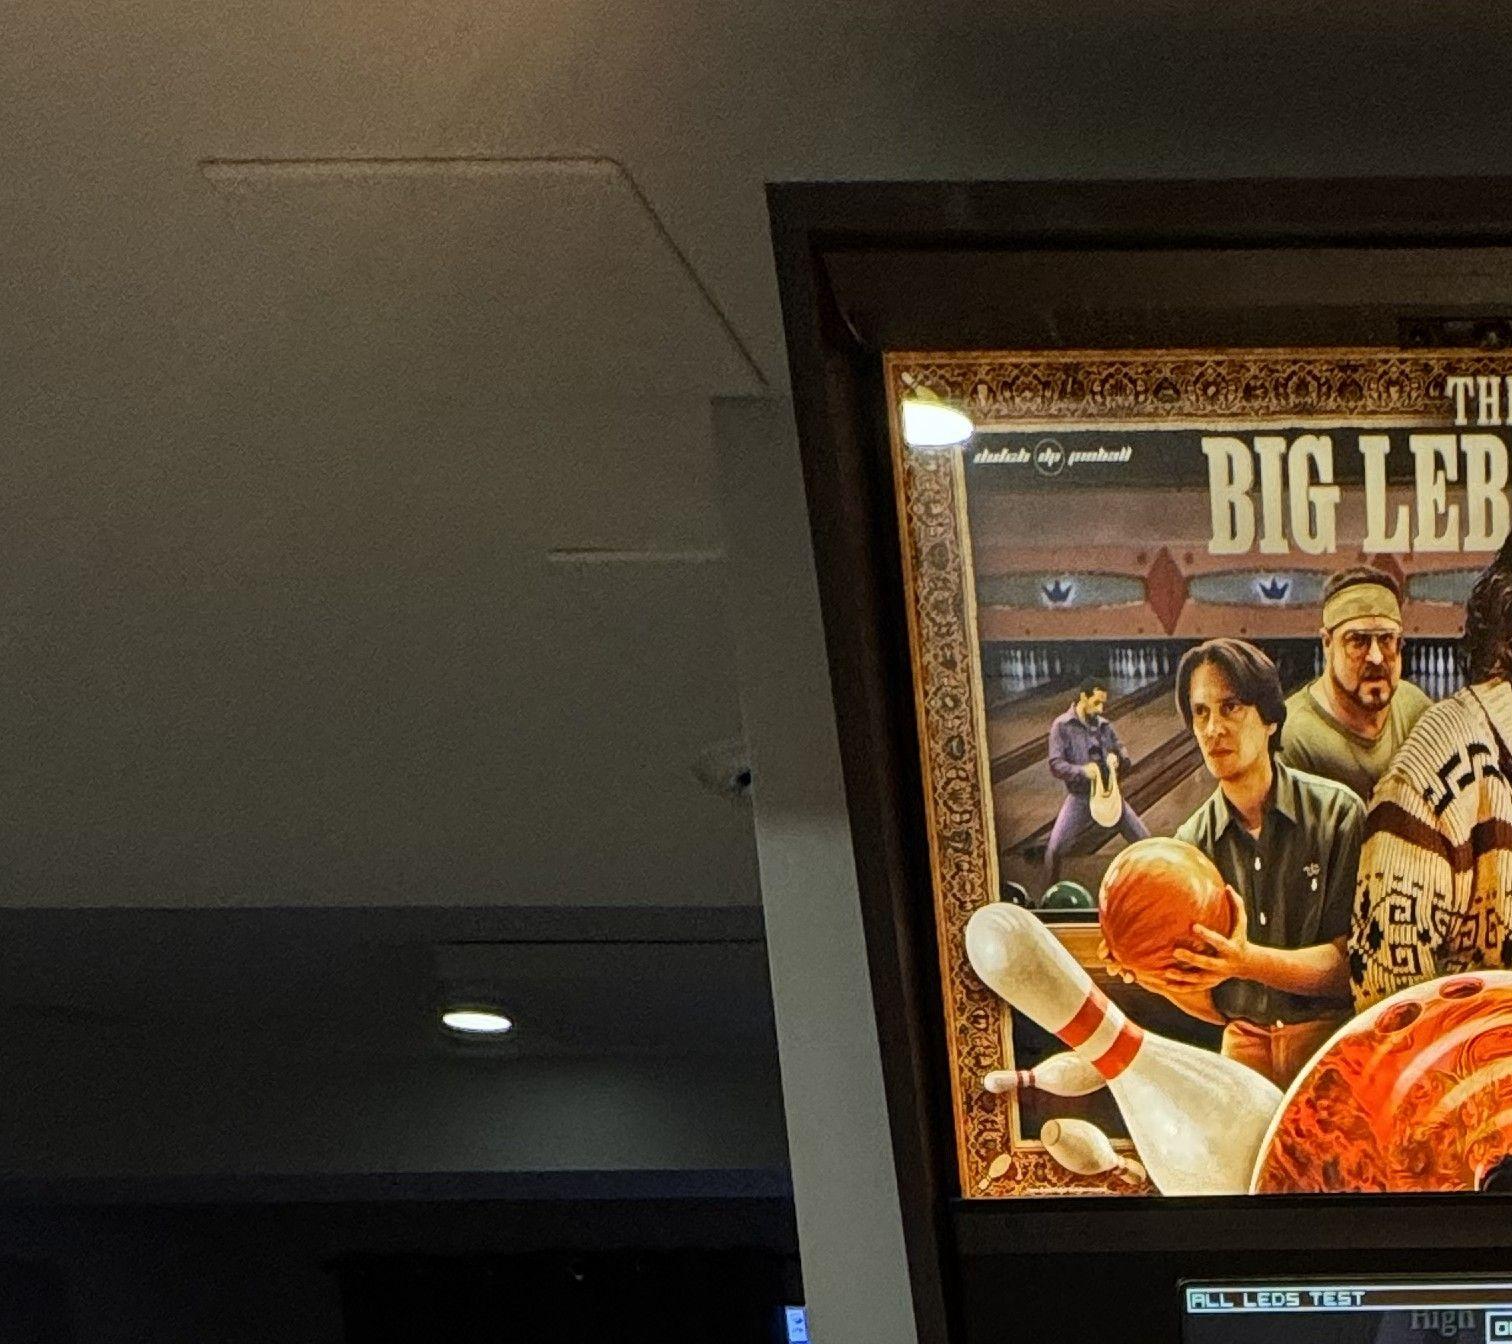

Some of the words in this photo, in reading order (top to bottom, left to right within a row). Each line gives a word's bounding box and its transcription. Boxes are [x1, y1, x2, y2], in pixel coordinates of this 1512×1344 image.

[1201, 433, 1340, 554] BIG
[1191, 1292, 1234, 1308] ALL
[1243, 1292, 1300, 1307] LEDS
[1309, 1291, 1366, 1306] TEST
